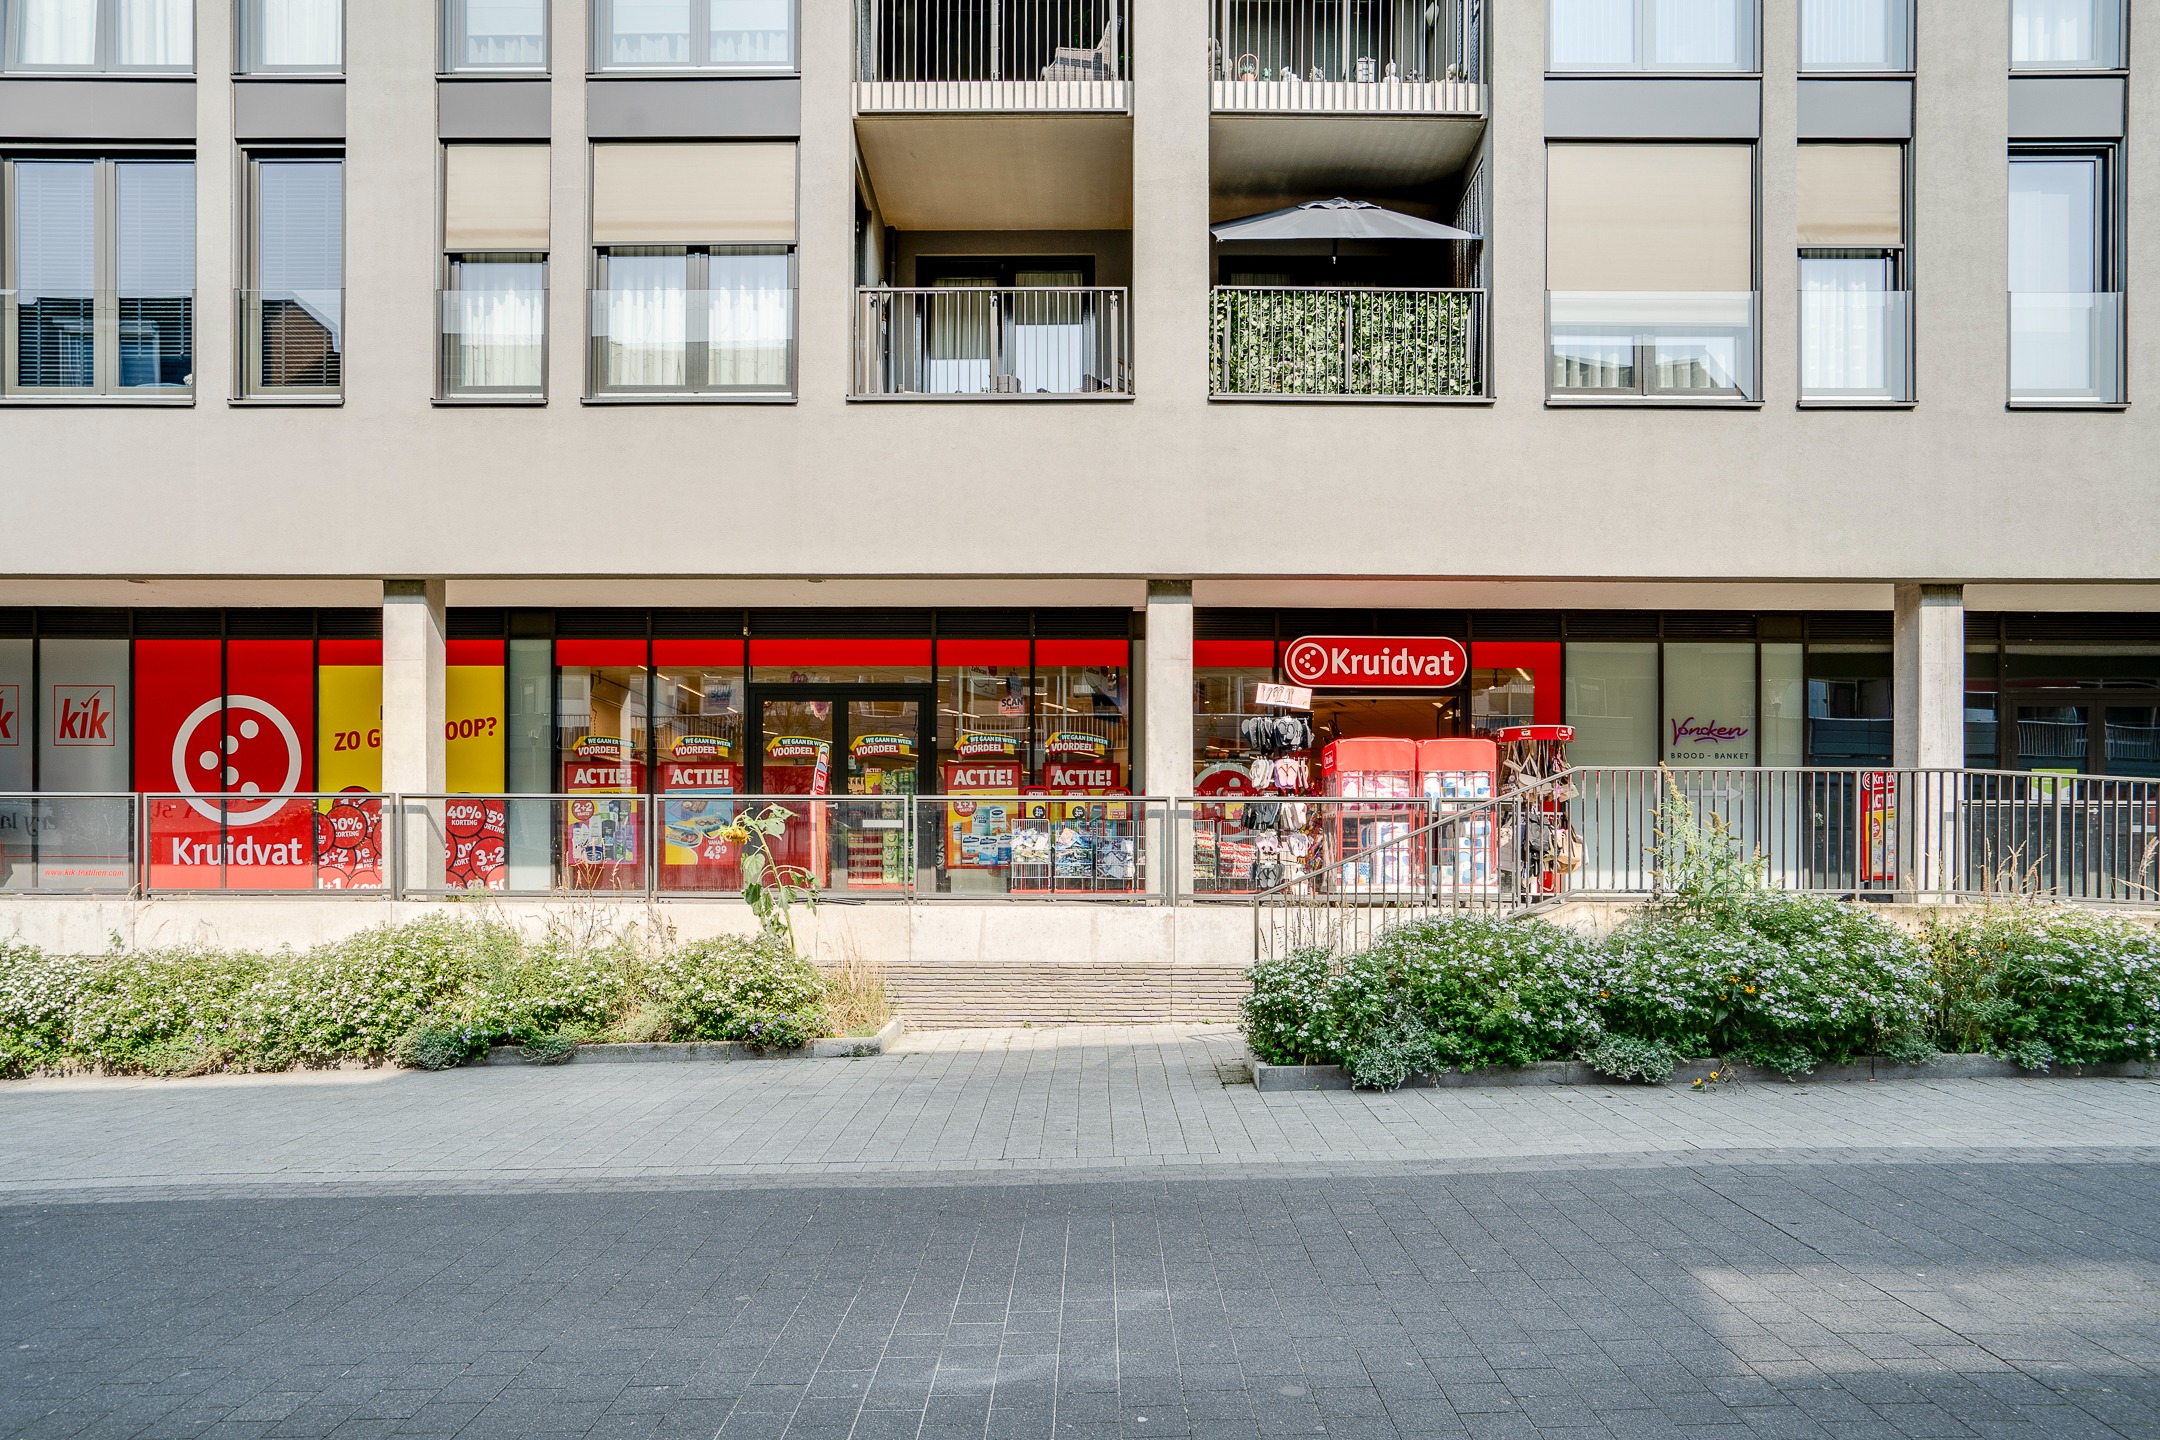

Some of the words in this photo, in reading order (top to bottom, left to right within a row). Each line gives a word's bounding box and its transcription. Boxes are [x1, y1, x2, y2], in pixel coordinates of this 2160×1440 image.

[1331, 647, 1455, 676] Kruidvat
[1001, 698, 1023, 707] SCAN
[59, 691, 110, 738] kik
[1671, 717, 1748, 745] Voncken
[334, 731, 360, 751] ZO
[1051, 742, 1093, 751] VOORDEEL
[578, 746, 619, 756] VOORDEEL
[675, 746, 717, 756] VOORDEEL
[772, 747, 814, 757] VOORDEEL
[856, 745, 898, 756] VOORDEEL
[961, 744, 1003, 755] VOORDEEL
[574, 768, 632, 784] ACTIE!
[671, 769, 729, 785] ACTIE!
[953, 769, 1012, 786] ACTIE!
[1052, 769, 1112, 786] ACTIE!
[447, 806, 482, 819] 40%
[574, 802, 592, 812] 2+2
[484, 823, 505, 834] ORTING
[172, 836, 303, 865] Kruidvat
[475, 846, 505, 866] 3+2
